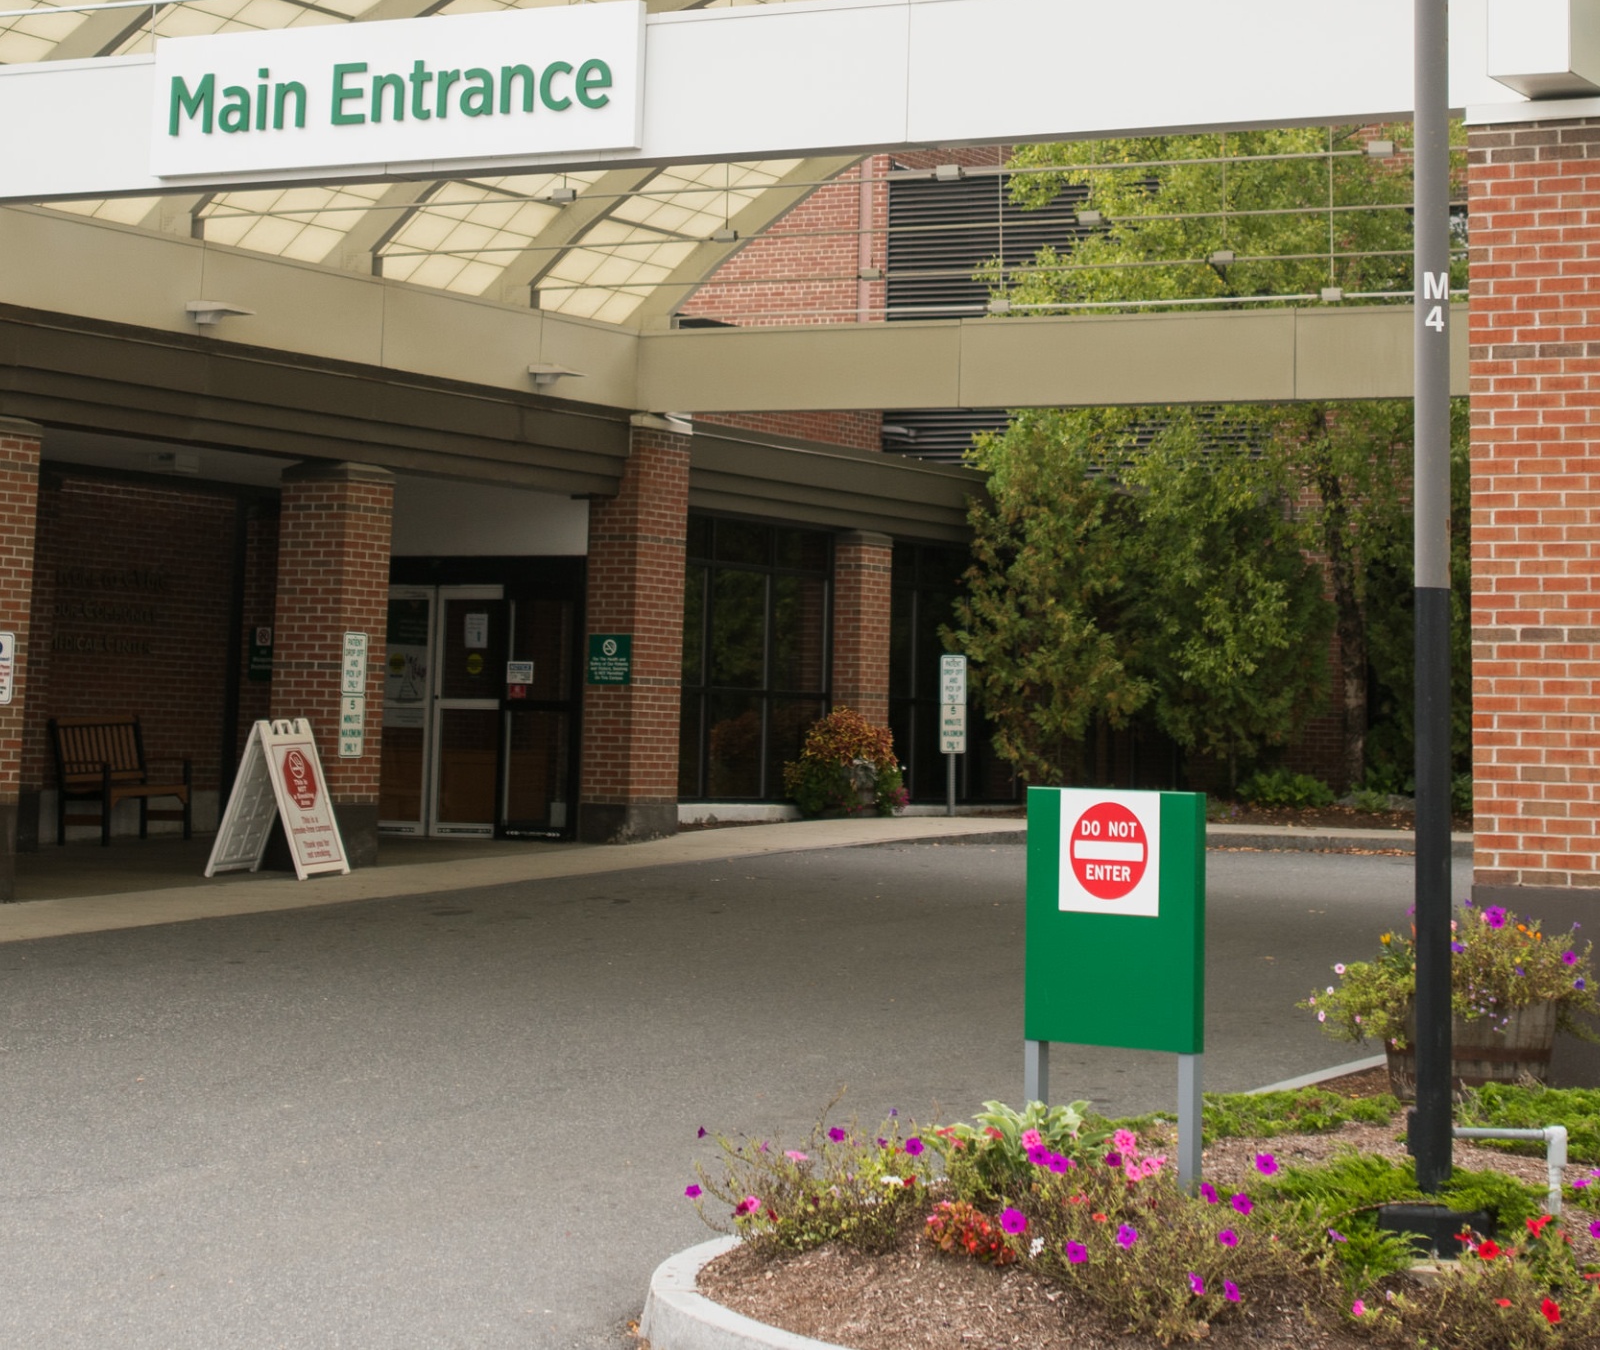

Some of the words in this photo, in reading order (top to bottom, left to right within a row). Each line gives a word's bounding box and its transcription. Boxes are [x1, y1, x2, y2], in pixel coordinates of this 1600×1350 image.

[168, 67, 307, 137] Main
[330, 57, 613, 126] Entrance
[1424, 272, 1448, 300] M
[1425, 306, 1444, 332] 4
[348, 638, 363, 647] PATIENT
[350, 700, 355, 710] 5
[951, 707, 956, 715] 5
[344, 715, 360, 724] MINUTE
[342, 729, 361, 737] MAXIMUM
[344, 743, 357, 752] ONLY
[947, 741, 959, 749] ONLY
[1081, 820, 1100, 837] DO
[1108, 822, 1137, 838] NOT
[1086, 864, 1131, 882] ENTER
